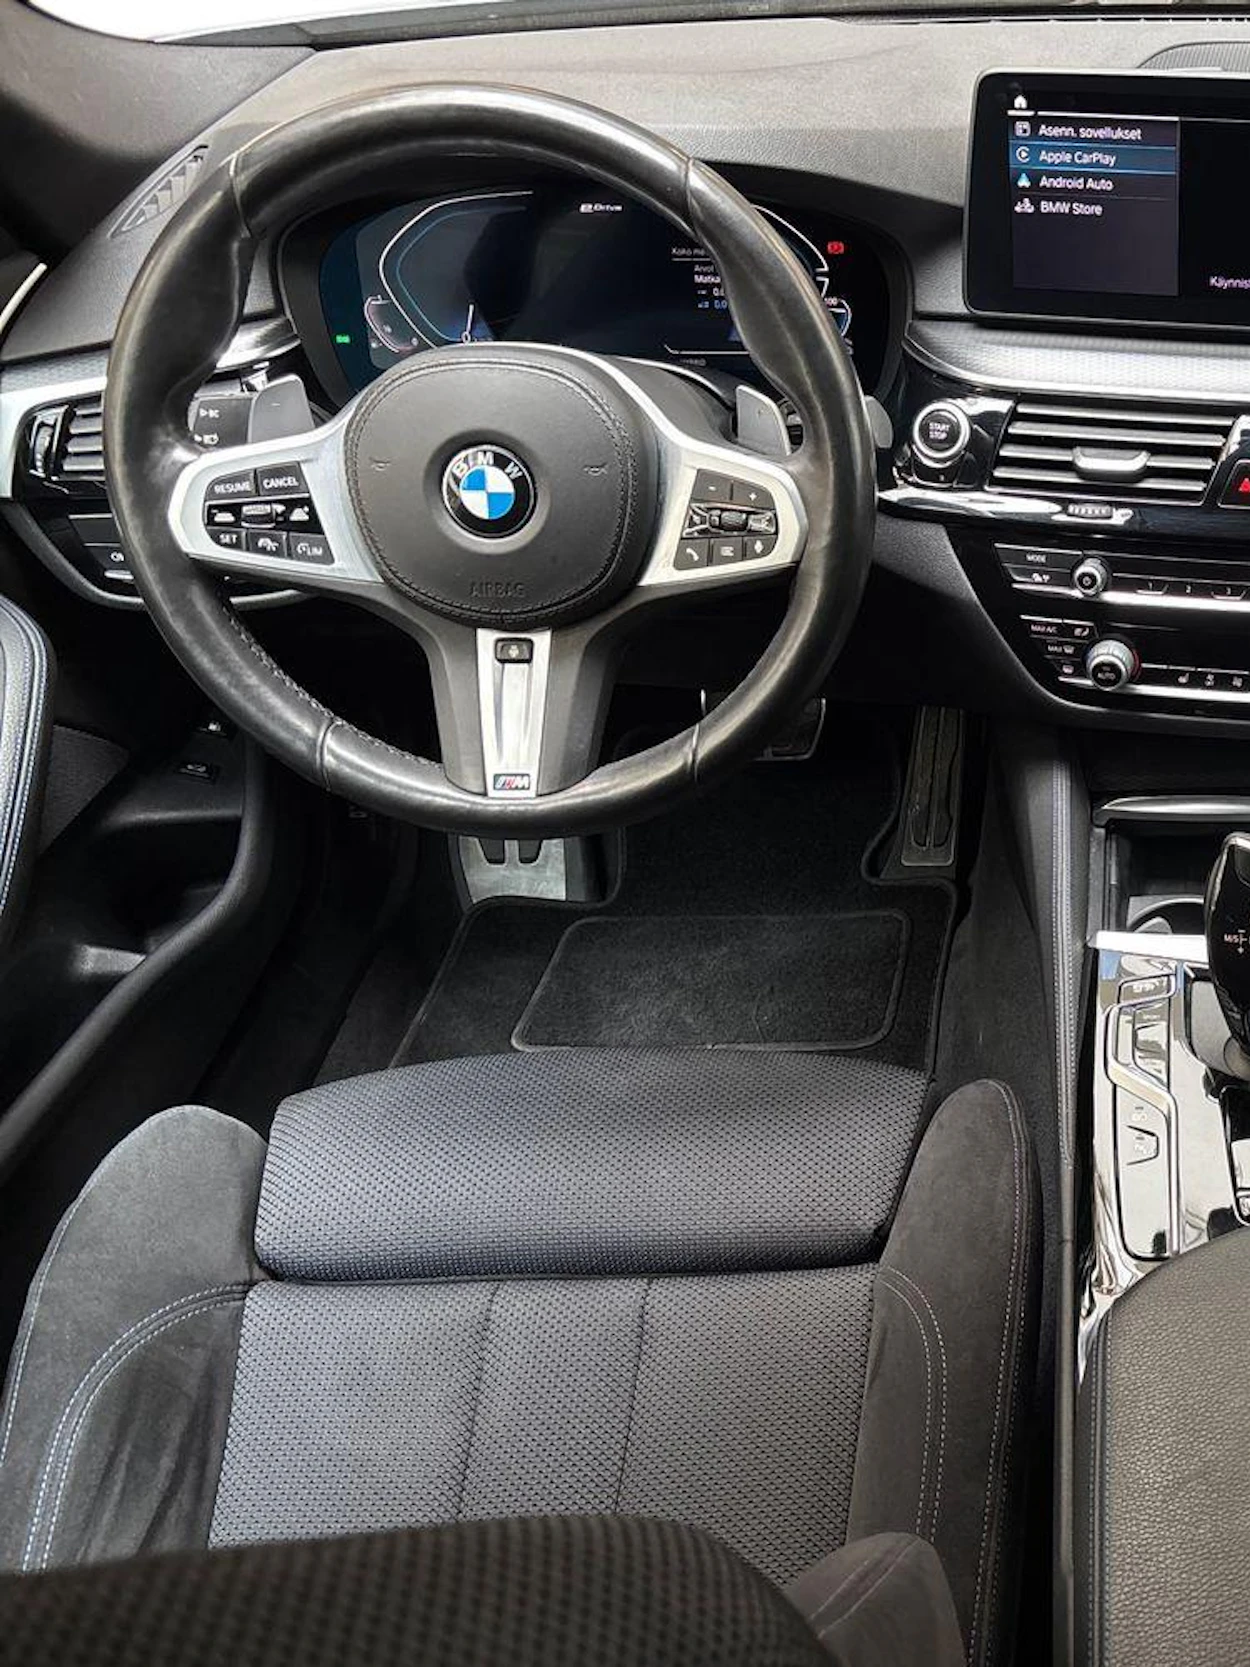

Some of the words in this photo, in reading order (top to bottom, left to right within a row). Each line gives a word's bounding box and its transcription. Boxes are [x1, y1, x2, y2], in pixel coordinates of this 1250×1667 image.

[1038, 124, 1077, 138] Asenn.
[1079, 127, 1142, 140] sovellukset
[1039, 151, 1072, 164] Apple
[1074, 152, 1116, 167] CarPlay
[1039, 175, 1085, 189] Android
[1086, 177, 1114, 191] Auto
[1040, 201, 1071, 213] BMW
[1072, 202, 1103, 216] Store
[451, 451, 523, 480] BMW
[213, 481, 251, 494] RESUME
[262, 476, 299, 489] CANCEL
[219, 533, 238, 544] SET
[1026, 554, 1046, 563] MODE
[469, 581, 526, 599] AIRBAG
